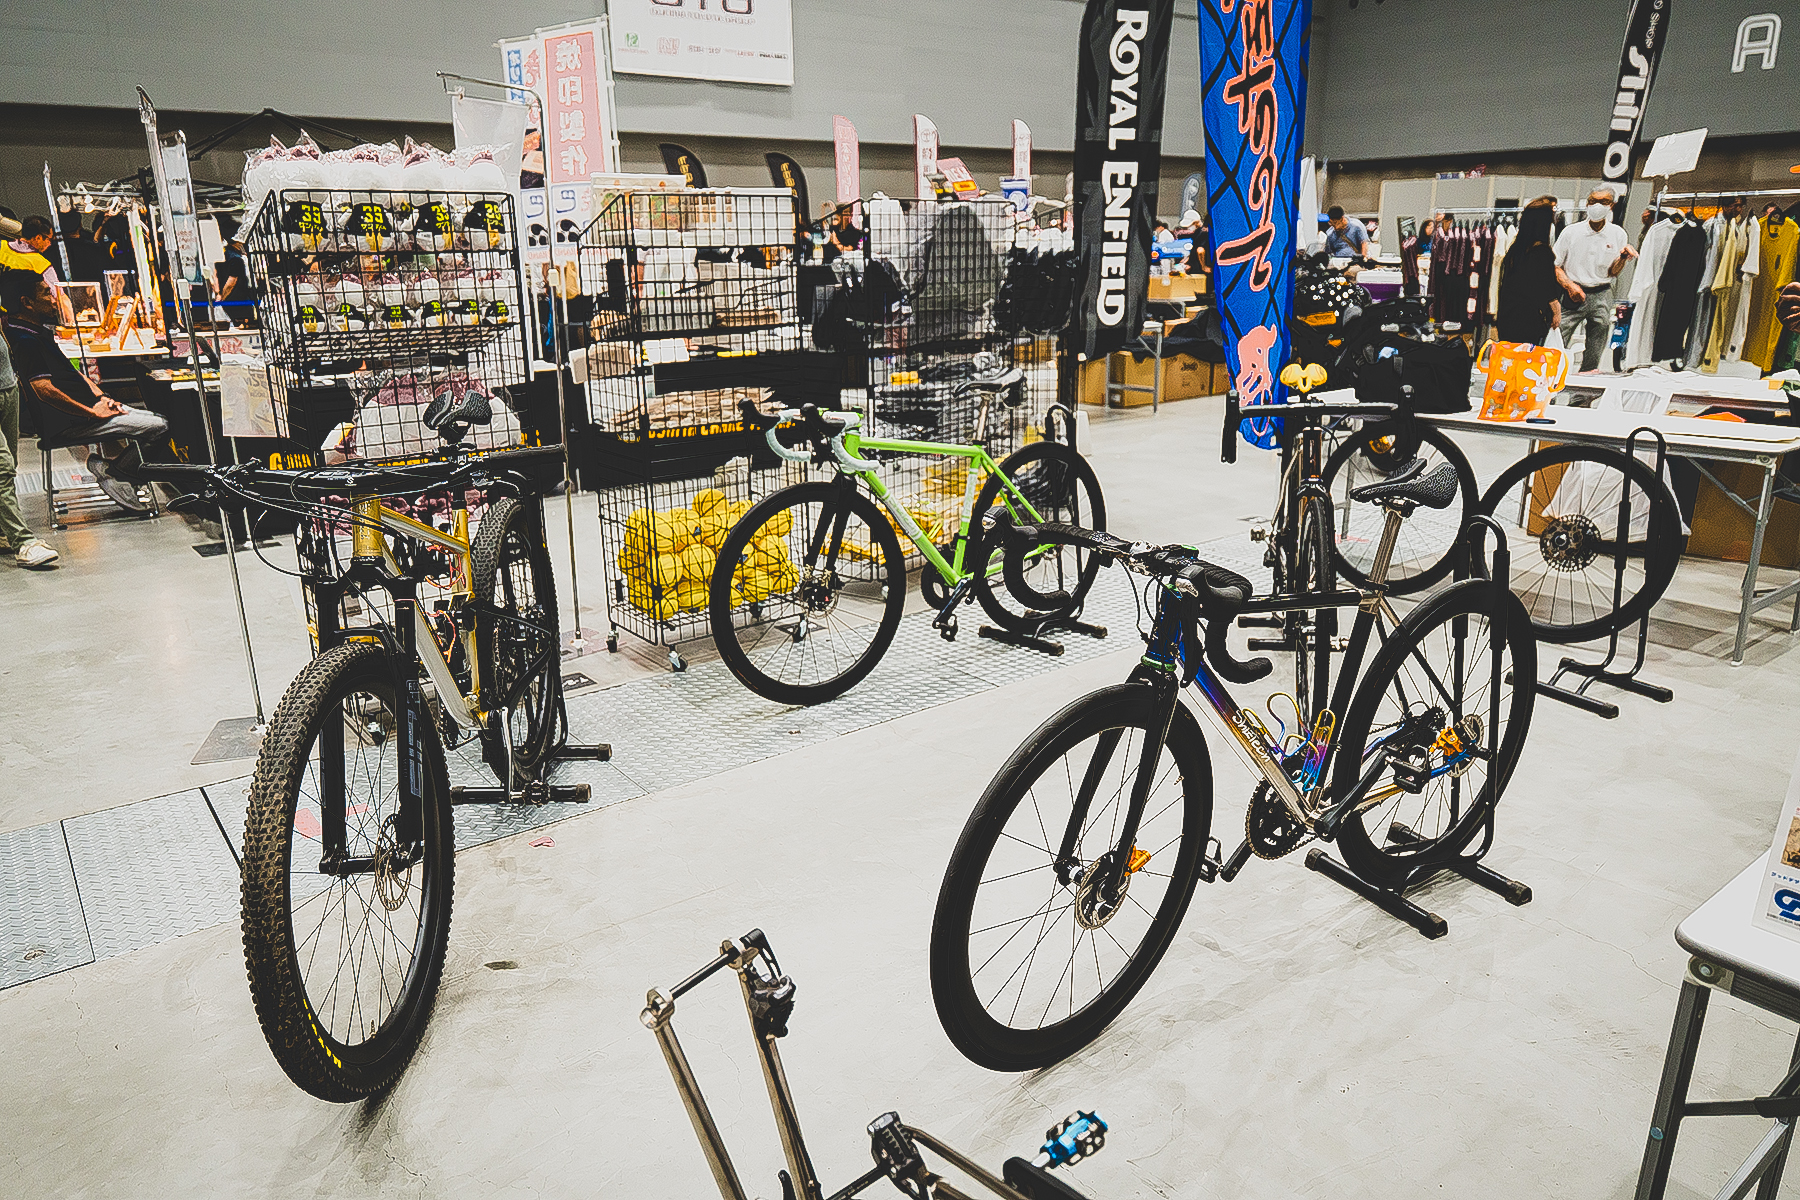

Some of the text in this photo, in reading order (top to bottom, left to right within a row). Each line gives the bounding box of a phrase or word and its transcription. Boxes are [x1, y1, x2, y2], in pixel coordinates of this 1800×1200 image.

[1731, 13, 1781, 73] A
[1096, 9, 1149, 325] ROYAL ENFIELD
